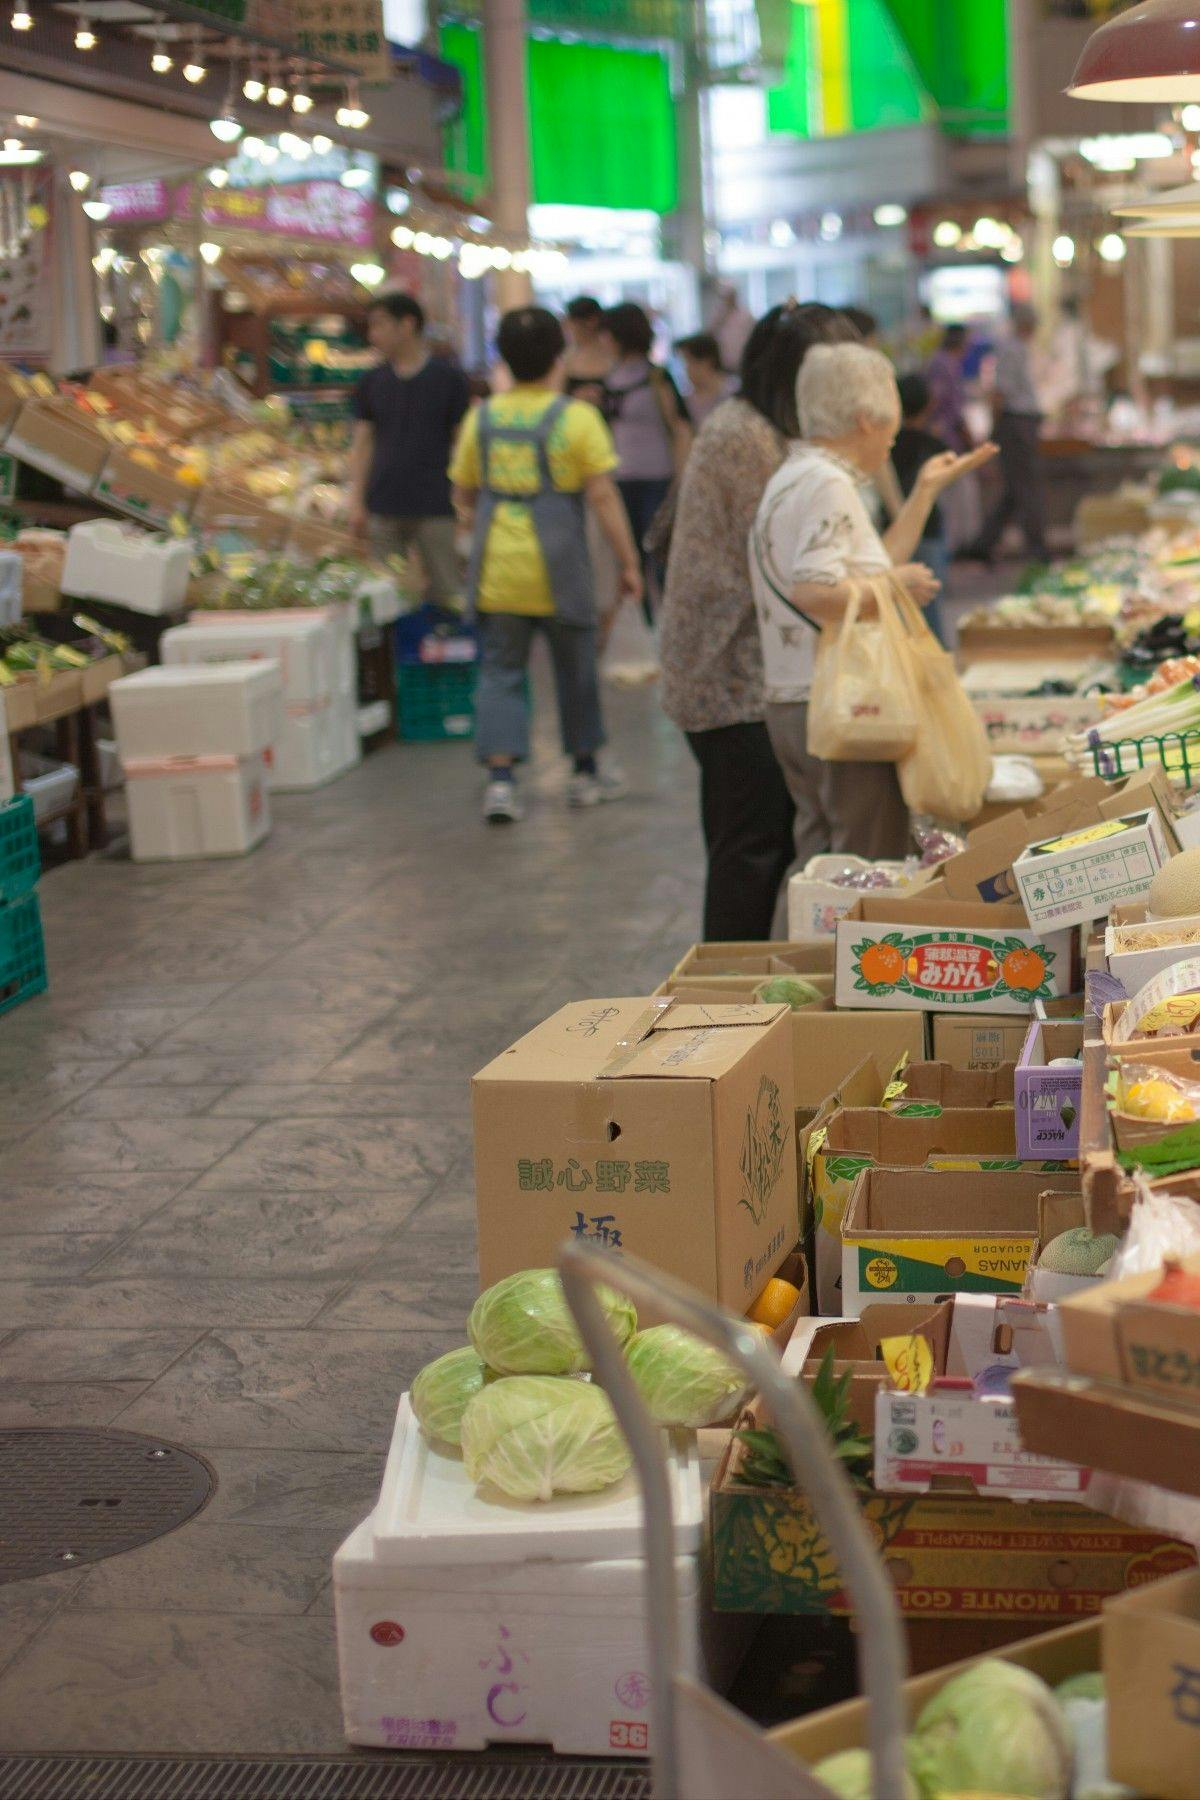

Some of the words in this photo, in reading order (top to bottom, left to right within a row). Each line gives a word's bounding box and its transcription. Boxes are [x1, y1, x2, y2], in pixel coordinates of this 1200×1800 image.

[920, 962, 985, 988] みかん
[517, 1158, 671, 1194] 誠心野菜
[974, 1245, 1030, 1254] ECUADOR
[915, 1533, 1003, 1547] PINEAPPLE
[1007, 1534, 1065, 1549] SWEET
[1070, 1535, 1121, 1550] EXTRA
[896, 1590, 952, 1608] GOL
[961, 1592, 1060, 1610] MONTE
